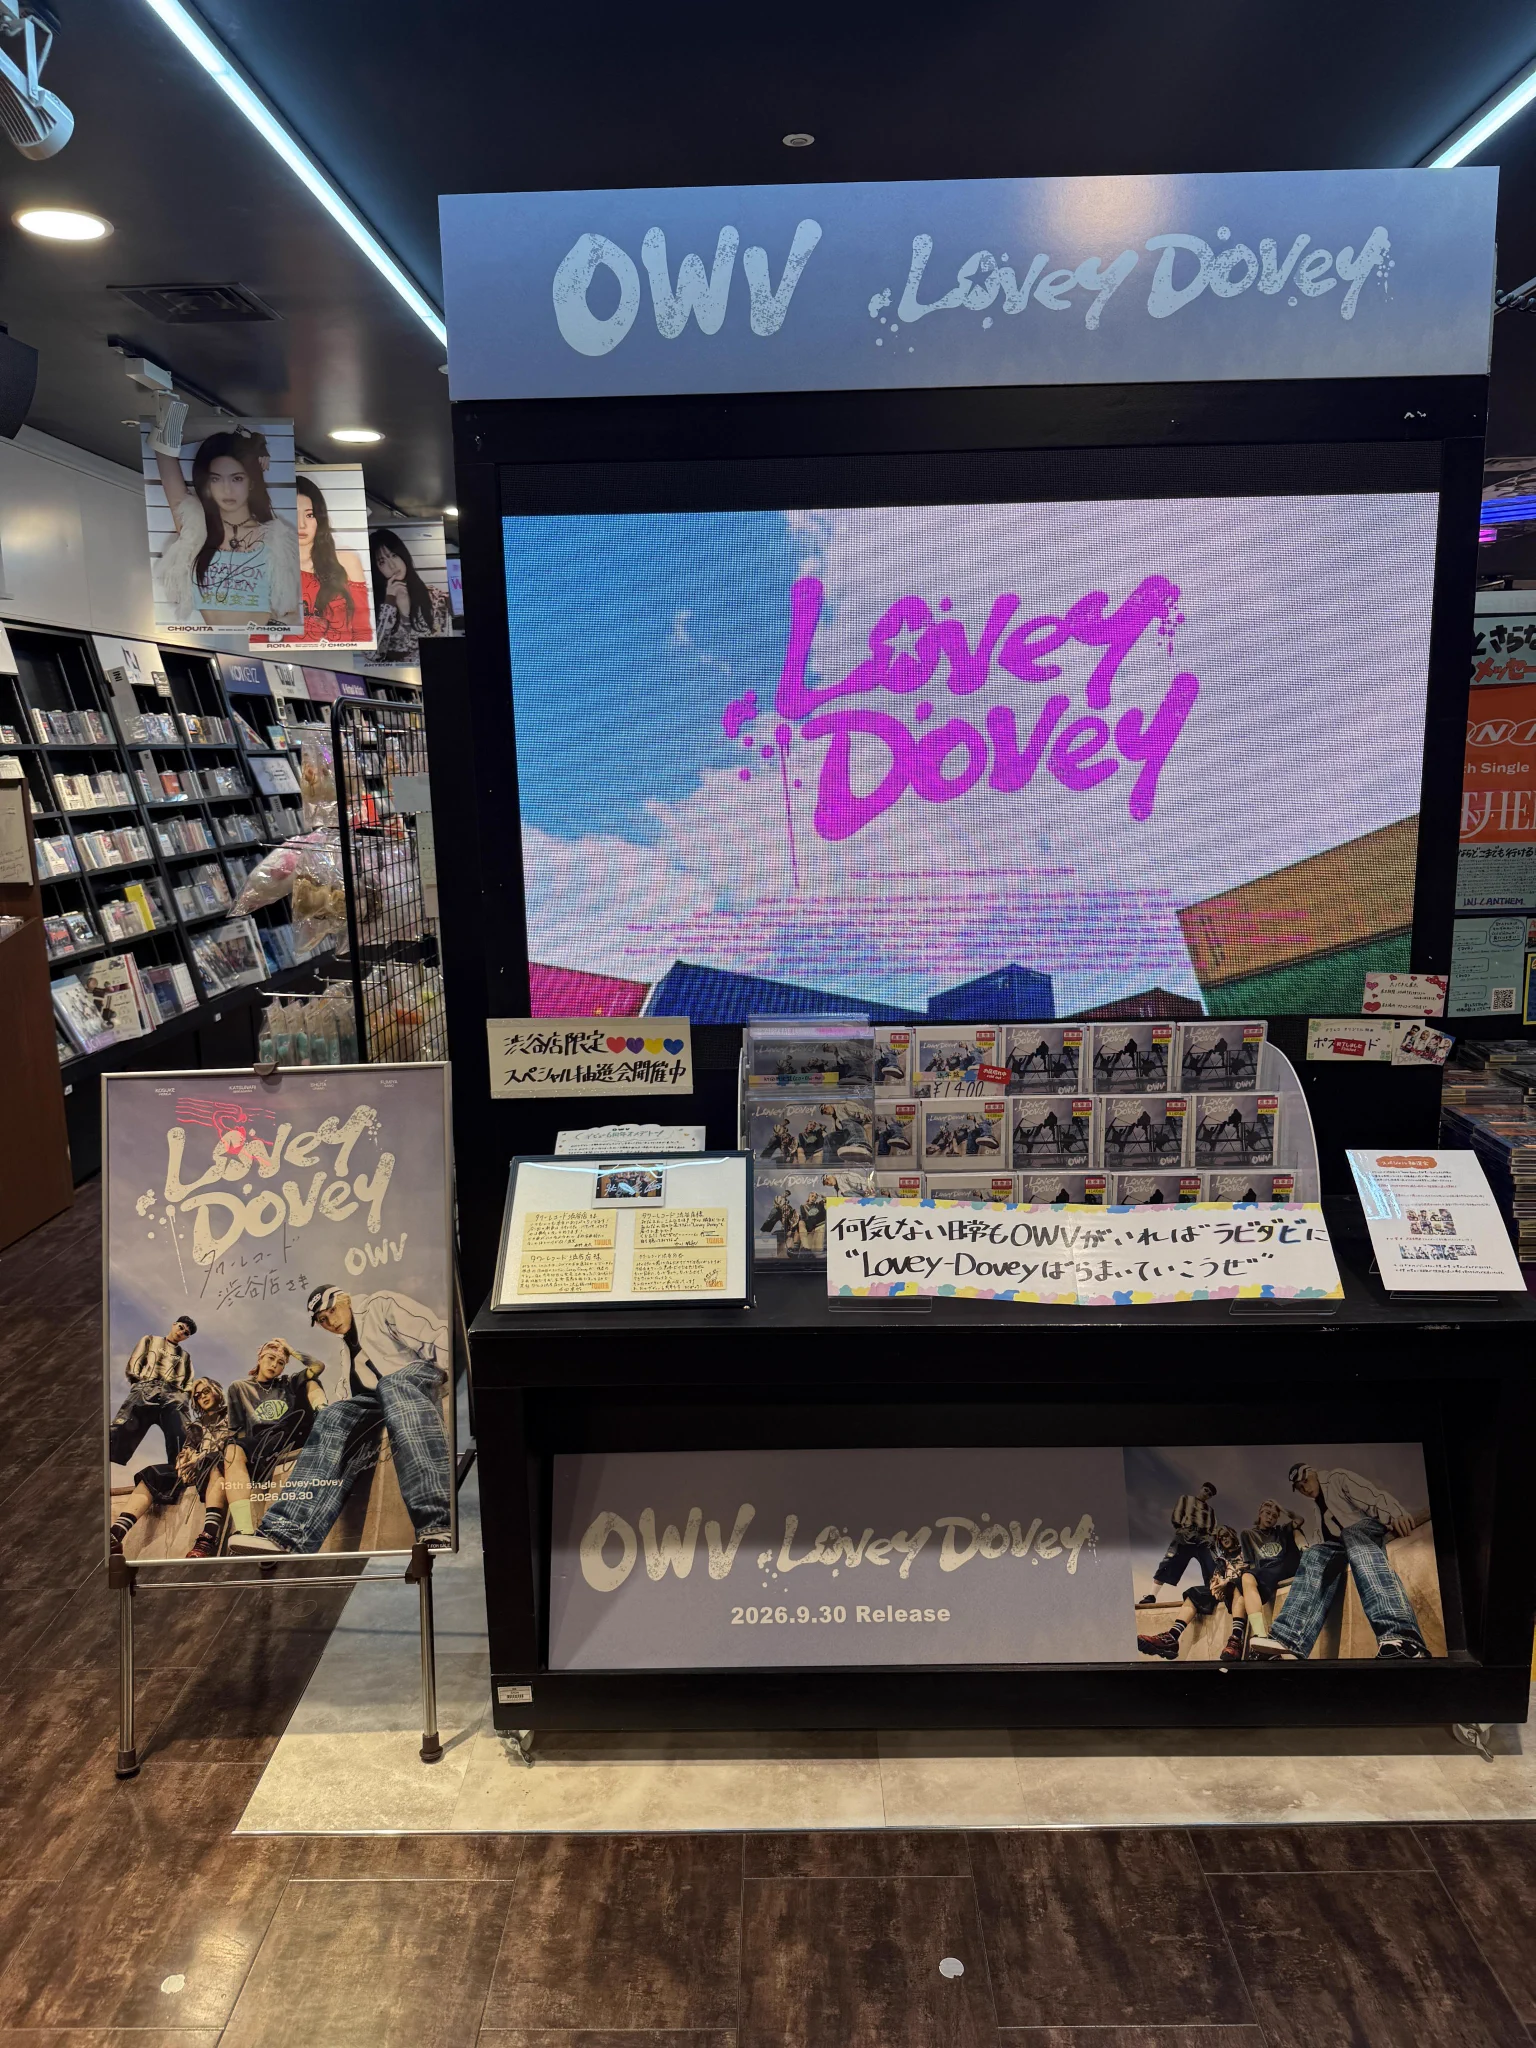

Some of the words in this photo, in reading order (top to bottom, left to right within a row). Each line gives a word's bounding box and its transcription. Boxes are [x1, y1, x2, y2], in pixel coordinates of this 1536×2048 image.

[553, 219, 822, 356] OWV
[897, 233, 1138, 331] Lovey
[1145, 226, 1390, 320] Dovey
[775, 575, 1180, 720] Lovey
[801, 672, 1200, 841] Dovey
[1463, 763, 1477, 774] h
[1480, 762, 1530, 775] Single
[504, 1029, 609, 1056] 渋谷店限定
[504, 1059, 687, 1086] スペシャル抽選会開催中
[164, 1105, 378, 1202] Lovey
[181, 1153, 395, 1266] Dovey
[344, 1232, 408, 1275] OWV
[220, 1481, 244, 1491] 13th
[246, 1480, 277, 1491] single
[279, 1478, 344, 1491] Lovey-Dovey
[250, 1491, 314, 1502] 2026.09.30
[579, 1503, 755, 1592] OWV
[776, 1513, 932, 1580] Lovey
[935, 1512, 1094, 1574] Dovey
[730, 1605, 847, 1625] 2026.9.30
[855, 1603, 951, 1623] Release
